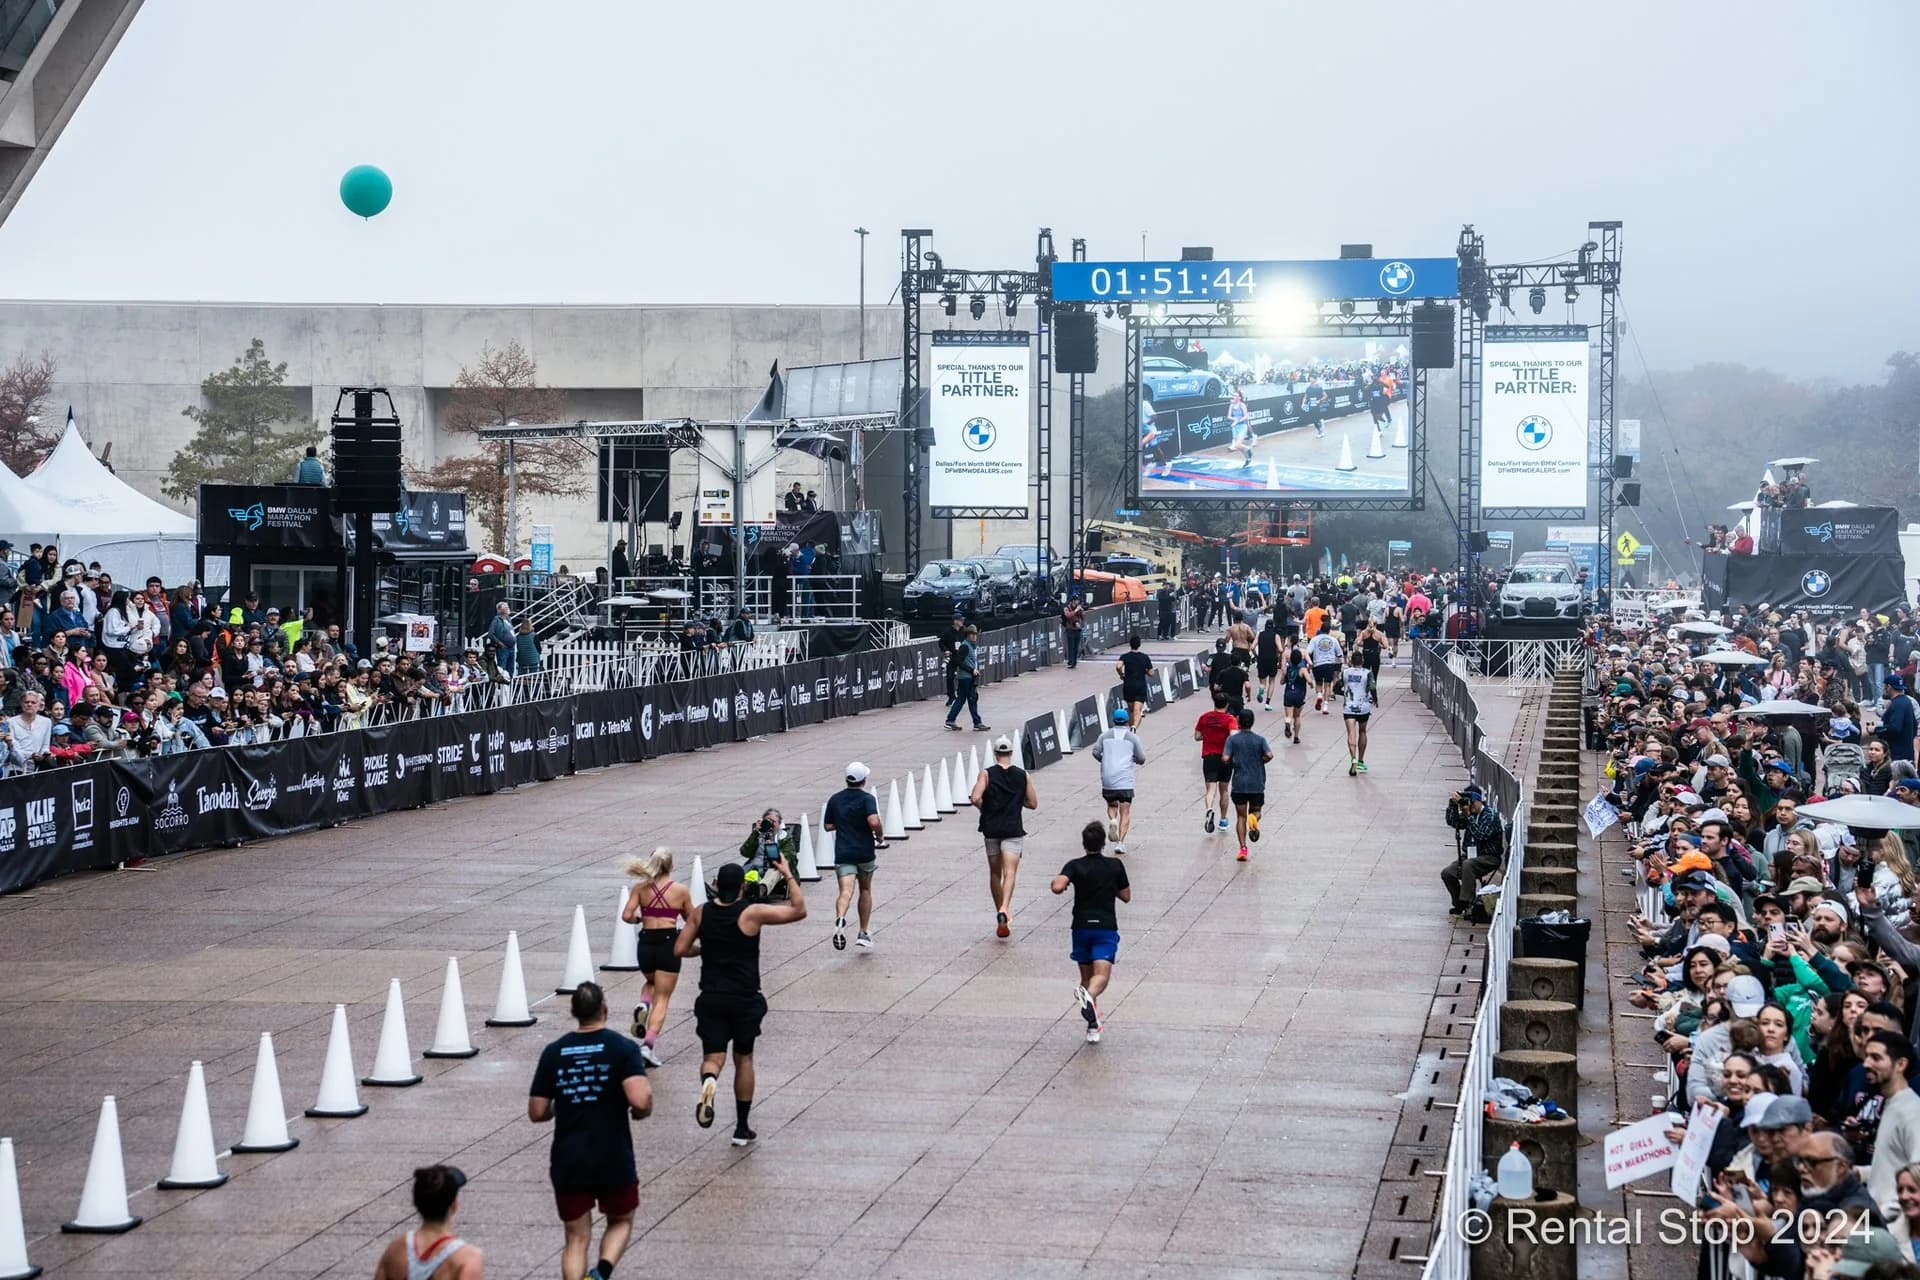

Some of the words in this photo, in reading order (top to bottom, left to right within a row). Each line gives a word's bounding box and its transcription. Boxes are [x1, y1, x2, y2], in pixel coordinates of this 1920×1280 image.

[1091, 267, 1258, 295] 01:51:44
[958, 372, 1002, 383] TITLE
[1512, 368, 1559, 380] TITLE
[942, 384, 1019, 397] PARTNER:
[1495, 381, 1577, 394] PARTNER:
[267, 506, 286, 514] BMW
[287, 507, 318, 515] DALLAS
[437, 743, 464, 764] STRIDE
[364, 753, 388, 771] PICKLE
[364, 770, 388, 788] JUICE
[196, 783, 239, 814] Tacodeli
[26, 797, 56, 826] KLIF
[154, 814, 189, 830] SOCORRO
[27, 825, 41, 841] 570
[1630, 1137, 1654, 1152] GIRLS
[1626, 1145, 1673, 1169] MARATHONS
